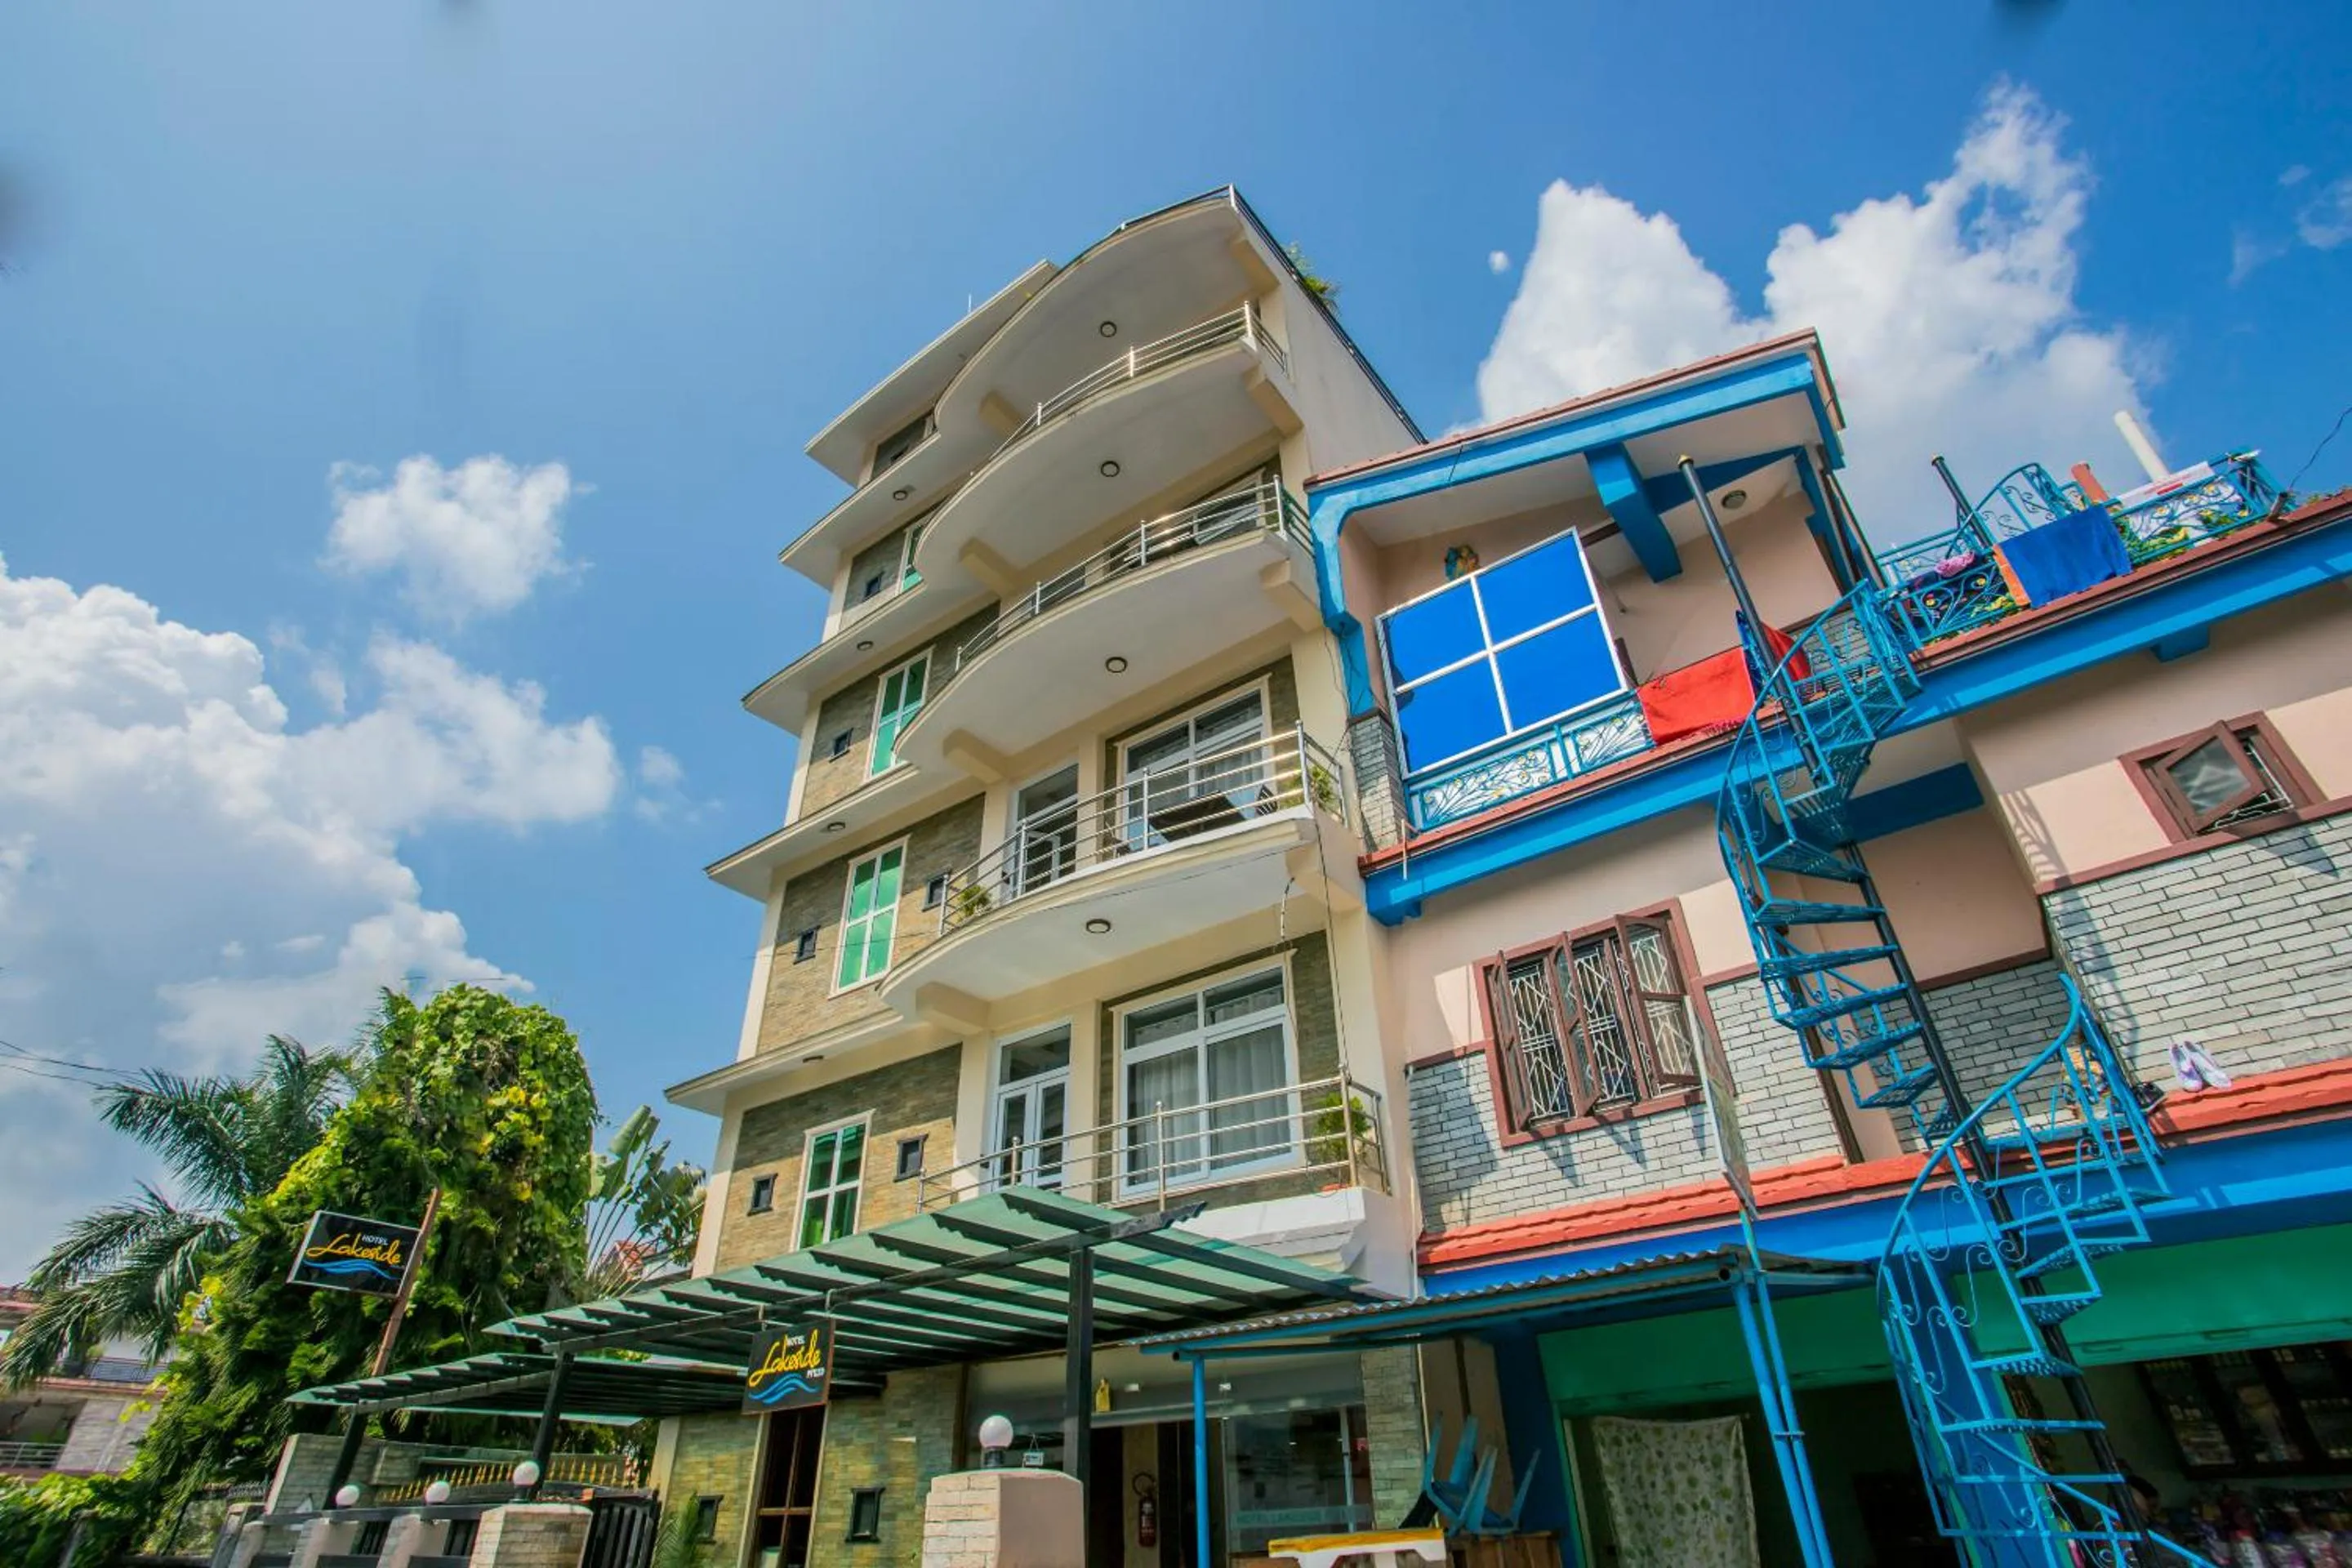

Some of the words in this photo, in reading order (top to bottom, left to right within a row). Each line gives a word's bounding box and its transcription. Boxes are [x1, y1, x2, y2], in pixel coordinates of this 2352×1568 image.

[305, 1232, 402, 1266] Lakeside
[362, 1234, 389, 1245] HOTEL
[748, 1329, 822, 1387] Lakeside
